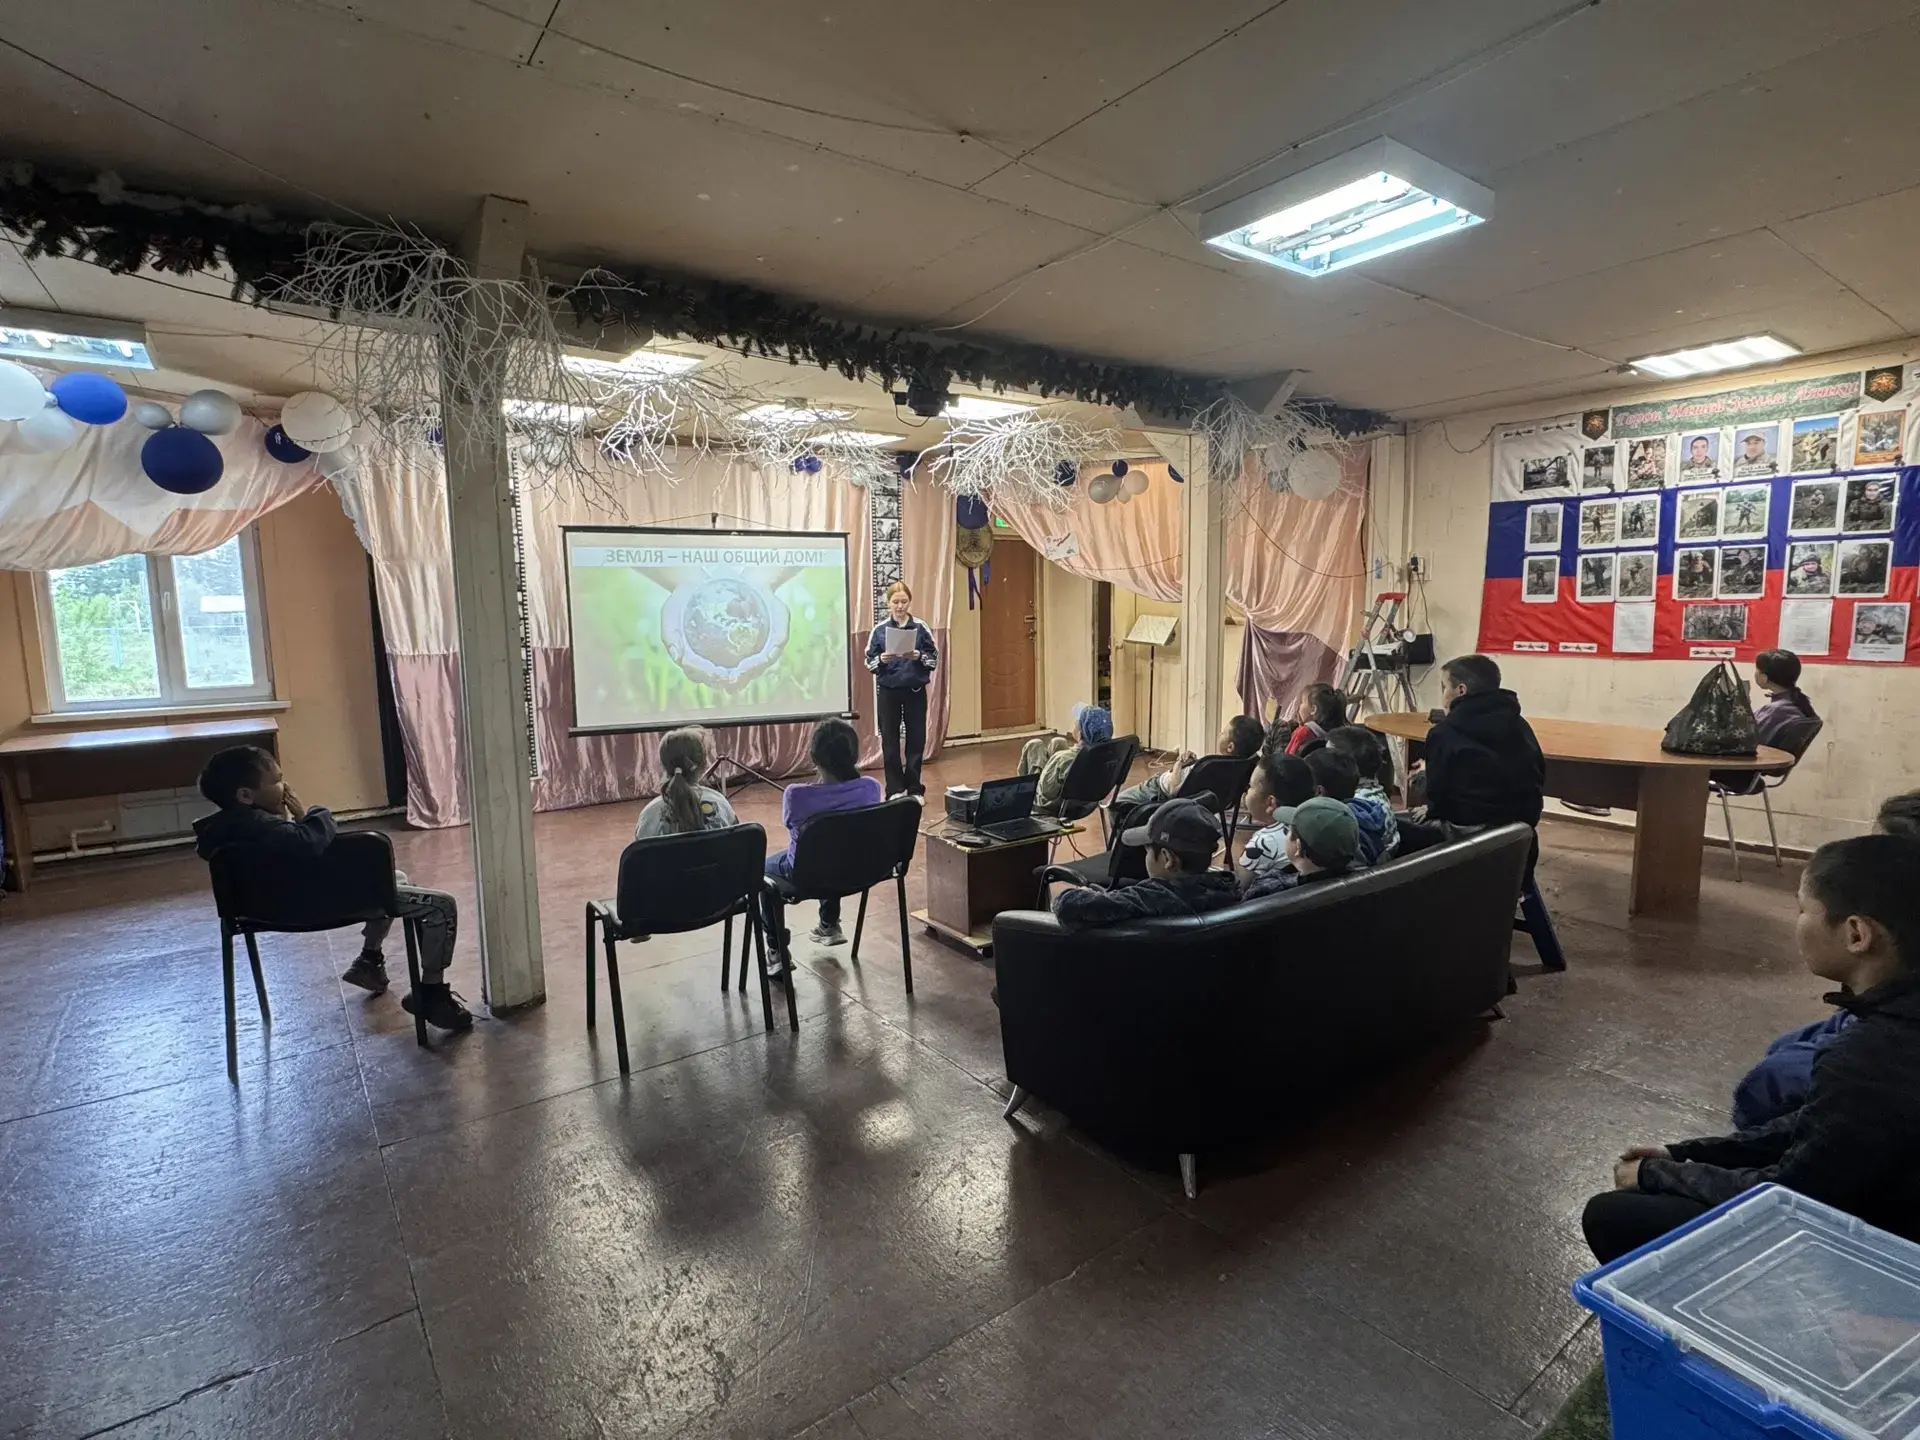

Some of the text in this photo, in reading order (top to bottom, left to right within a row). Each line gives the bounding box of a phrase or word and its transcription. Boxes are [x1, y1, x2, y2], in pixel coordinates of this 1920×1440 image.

[606, 549, 664, 564] ЗЕМЛЯ
[682, 550, 719, 564] НАШ
[723, 549, 780, 566] ОБЩИЙ
[783, 550, 823, 566] ДОМ!
